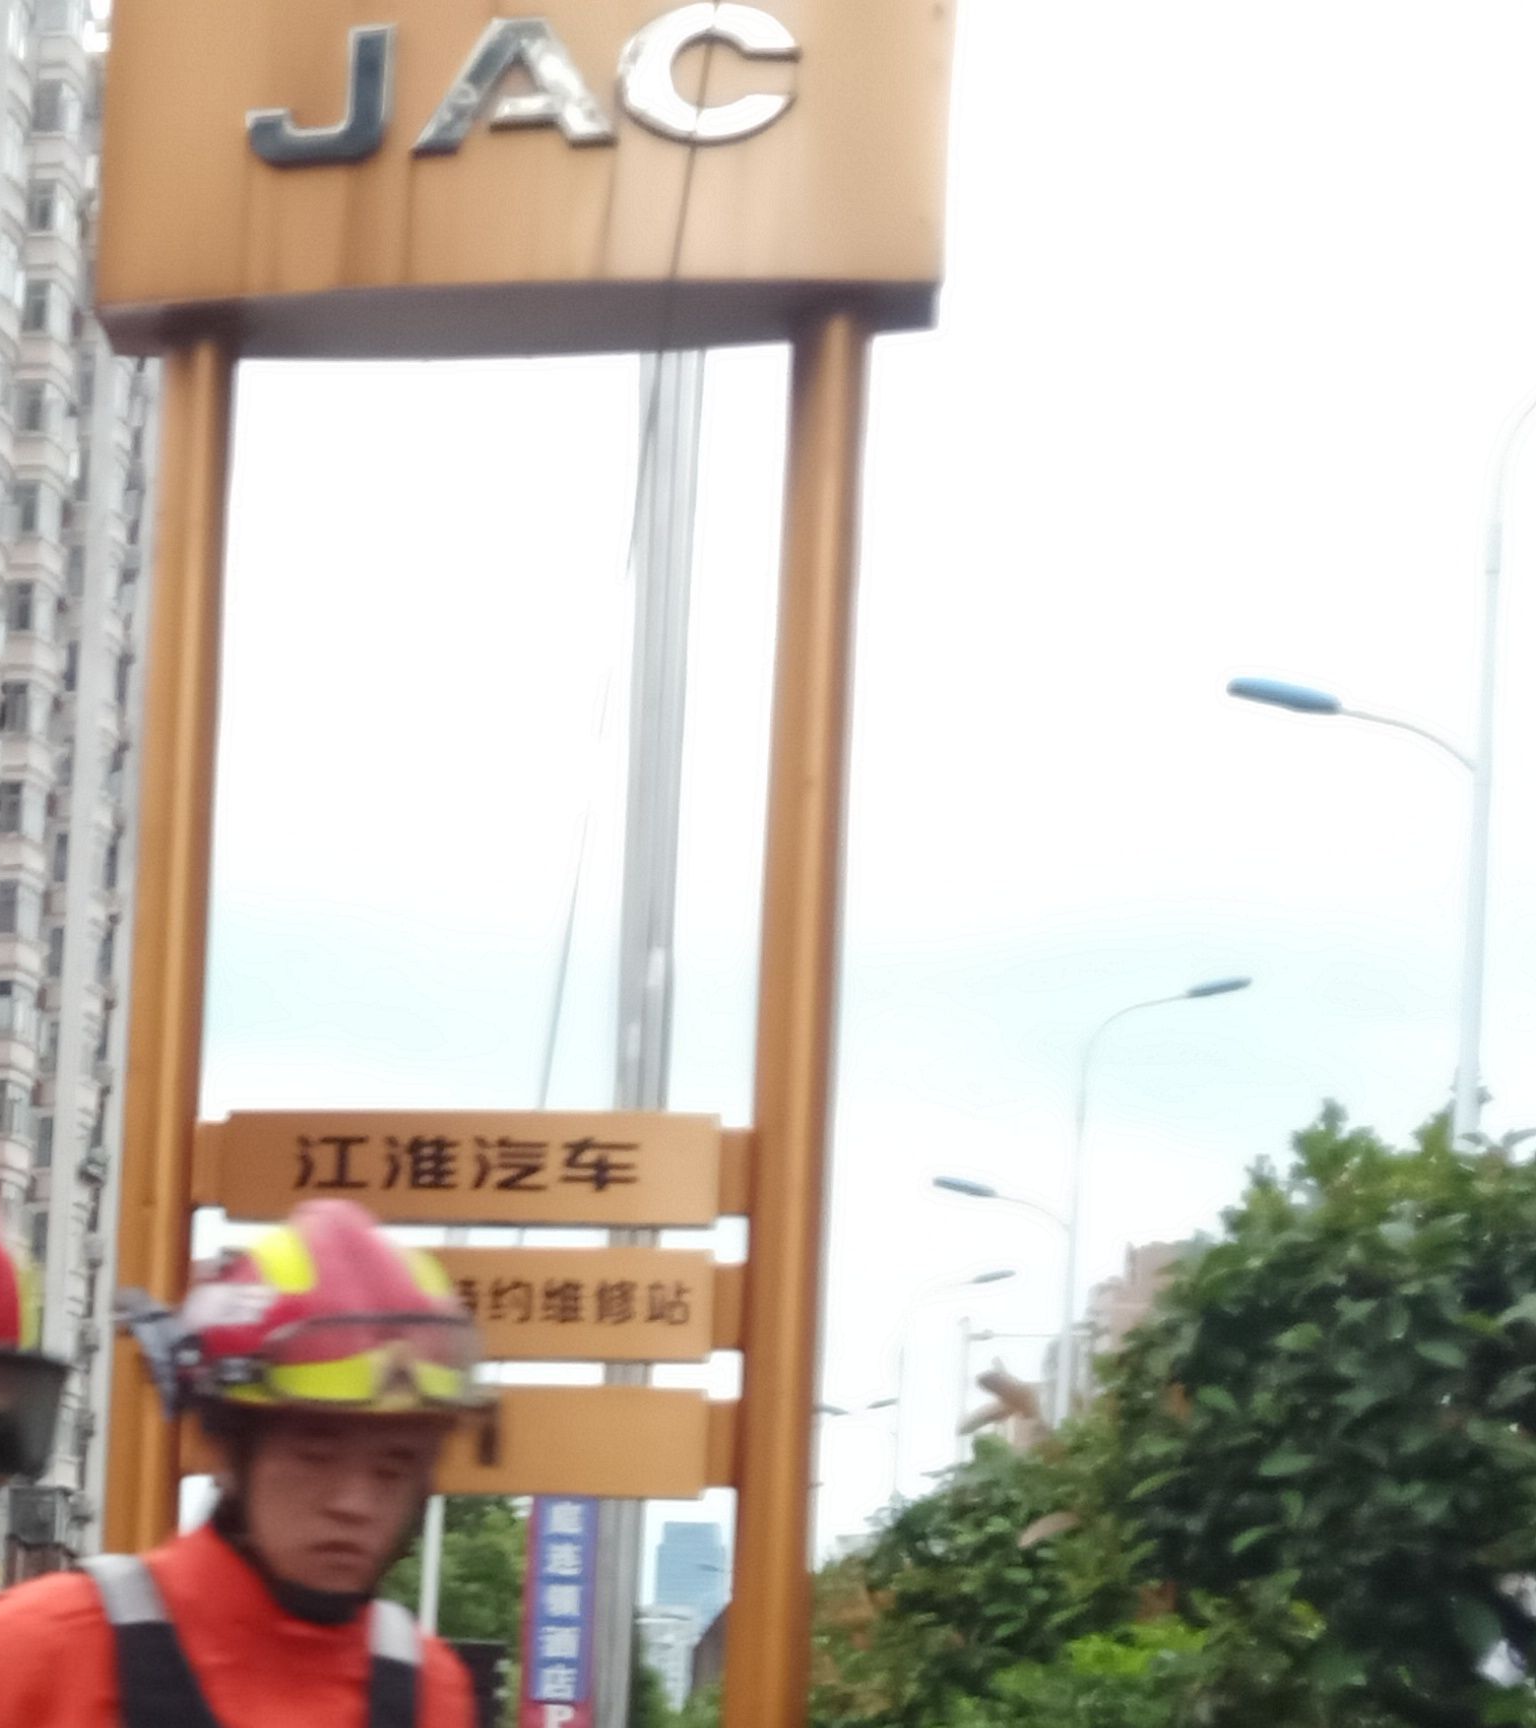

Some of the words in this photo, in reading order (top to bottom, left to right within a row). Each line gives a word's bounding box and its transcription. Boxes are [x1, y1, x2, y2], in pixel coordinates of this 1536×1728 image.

[245, 1, 801, 168] JAC
[292, 1134, 641, 1193] 江淮汽车
